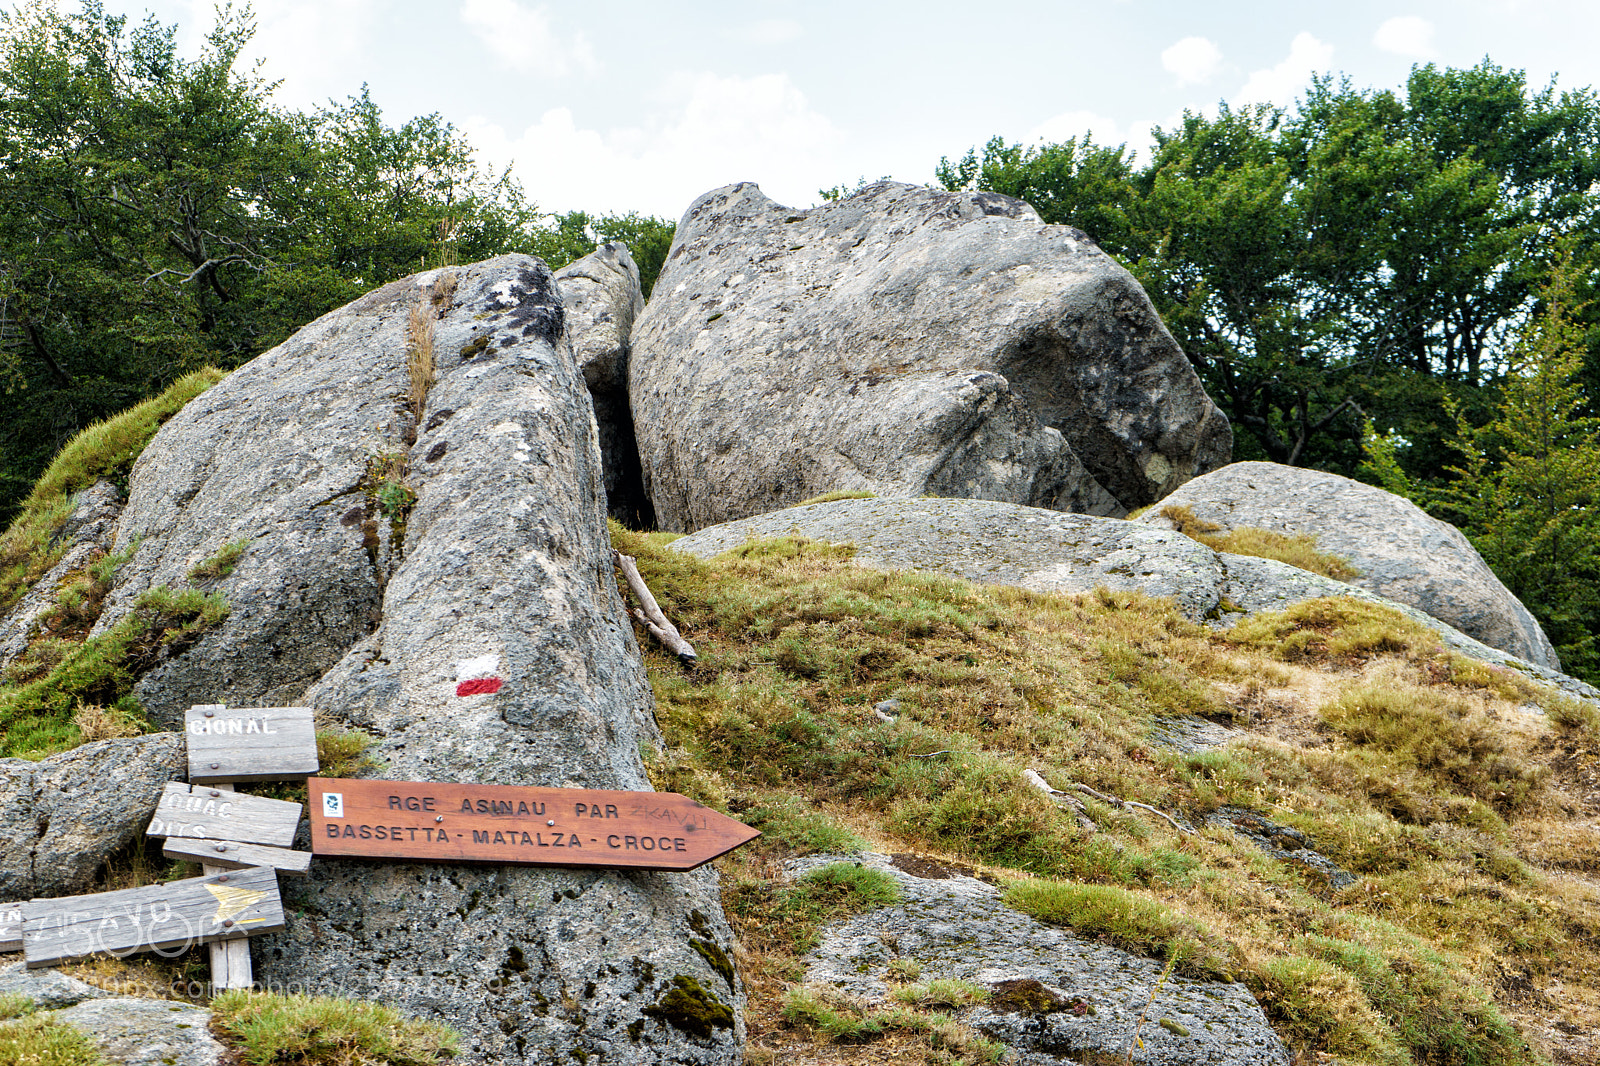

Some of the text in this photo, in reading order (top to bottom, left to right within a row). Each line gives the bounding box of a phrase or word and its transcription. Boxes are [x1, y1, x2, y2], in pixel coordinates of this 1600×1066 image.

[388, 796, 619, 819] RGE ASINAU PAR
[606, 834, 687, 852] CROCE
